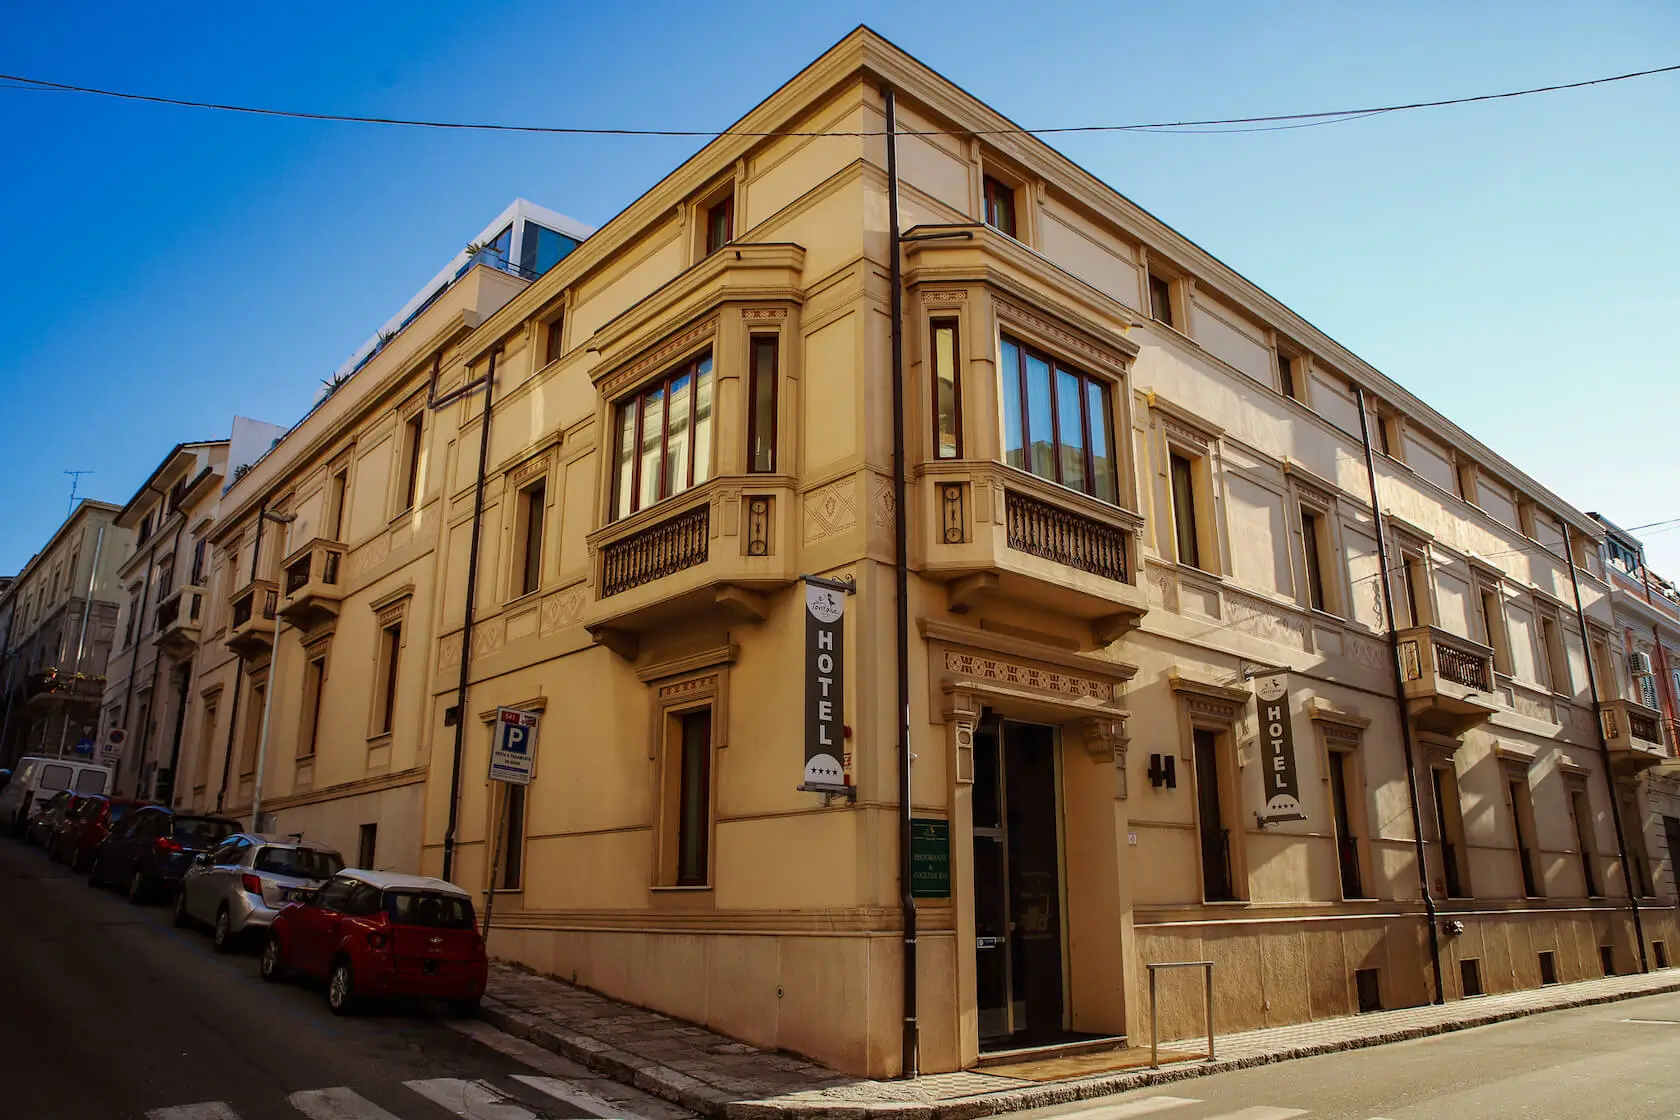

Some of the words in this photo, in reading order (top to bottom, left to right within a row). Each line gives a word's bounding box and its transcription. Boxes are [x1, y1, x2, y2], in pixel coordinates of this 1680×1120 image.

[817, 629, 834, 746] HOTEL
[507, 727, 524, 748] P
[1267, 705, 1287, 788] HOTEL
